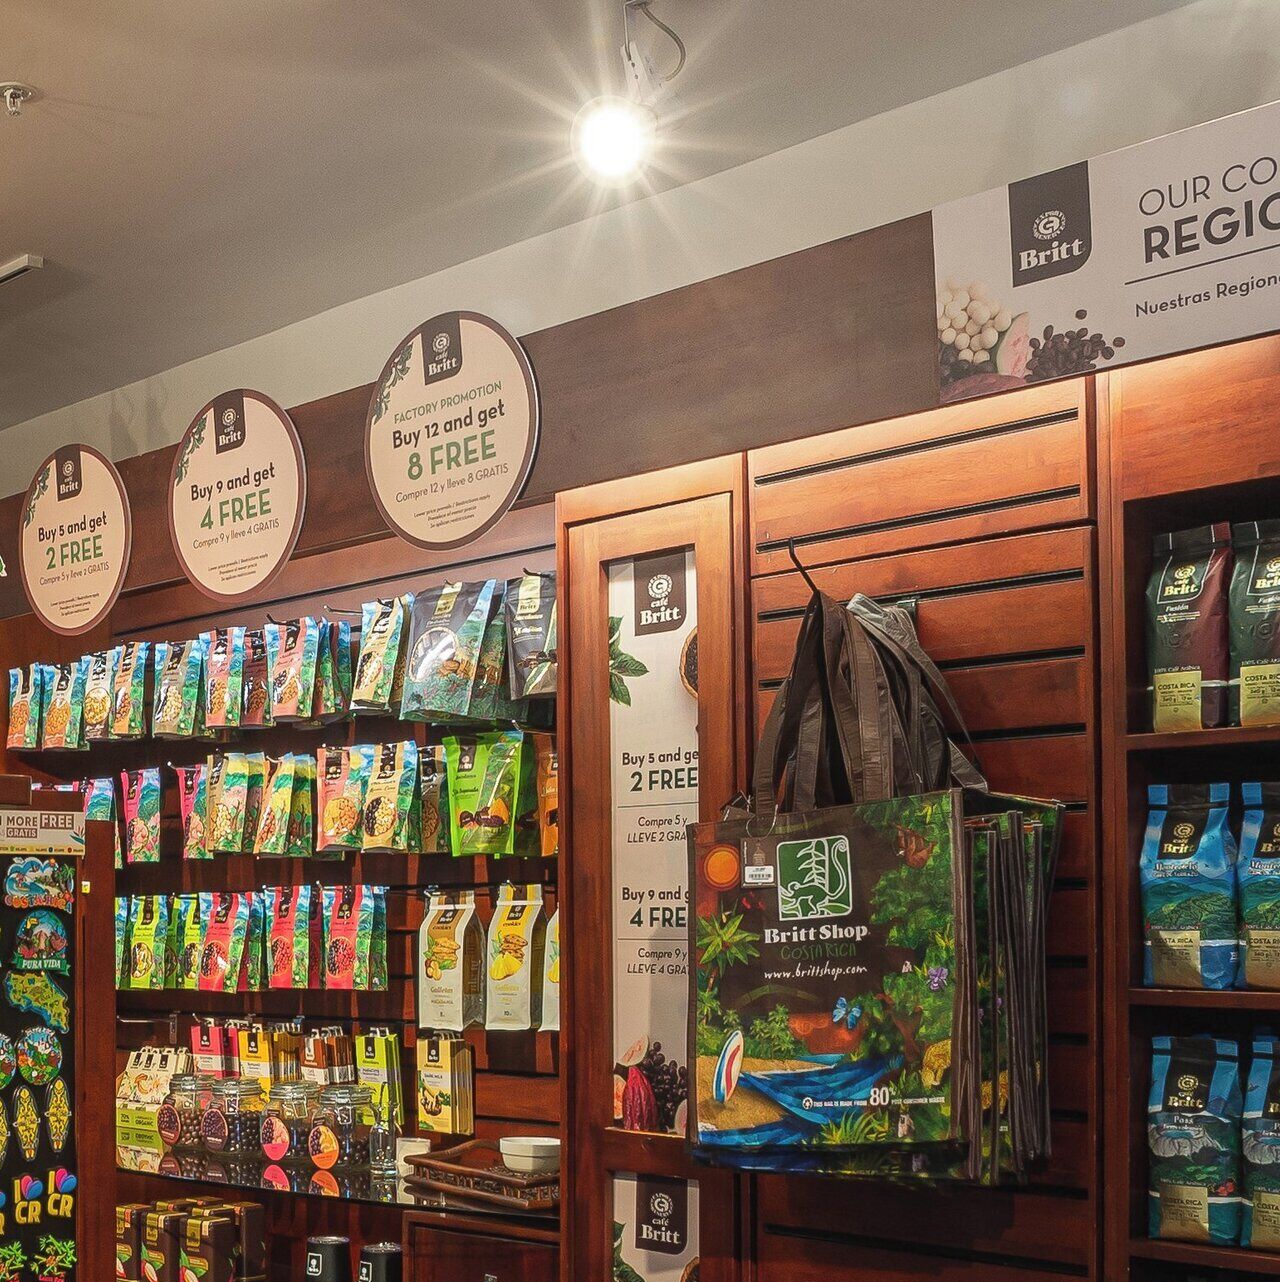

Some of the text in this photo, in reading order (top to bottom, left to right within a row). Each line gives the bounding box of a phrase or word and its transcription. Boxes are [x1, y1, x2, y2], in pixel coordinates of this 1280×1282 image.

[1139, 174, 1211, 217] OUR
[1019, 237, 1084, 271] Britt
[1135, 287, 1211, 318] Nuestras
[428, 357, 458, 376] Britt
[394, 381, 502, 424] FACTORY PROMOTION
[392, 399, 505, 449] Buy 12 and get
[219, 430, 241, 447] Britt
[407, 429, 497, 481] 8 FREE
[60, 482, 79, 495] Britt
[191, 462, 275, 501] Buy 9 and get
[200, 488, 272, 529] 4 FREE
[38, 511, 107, 543] Buy 5 and get
[46, 534, 103, 570] 2 FREE
[640, 607, 681, 626] Britt
[622, 747, 699, 768] Buy 5 and ge
[630, 767, 698, 792] 2 FREE
[6, 815, 38, 827] MORE
[41, 815, 74, 828] FREE
[7, 828, 37, 838] GRATIS
[764, 923, 869, 944] Britt Shop
[764, 960, 867, 981] www.brittshop.com
[641, 1224, 681, 1245] Britt
